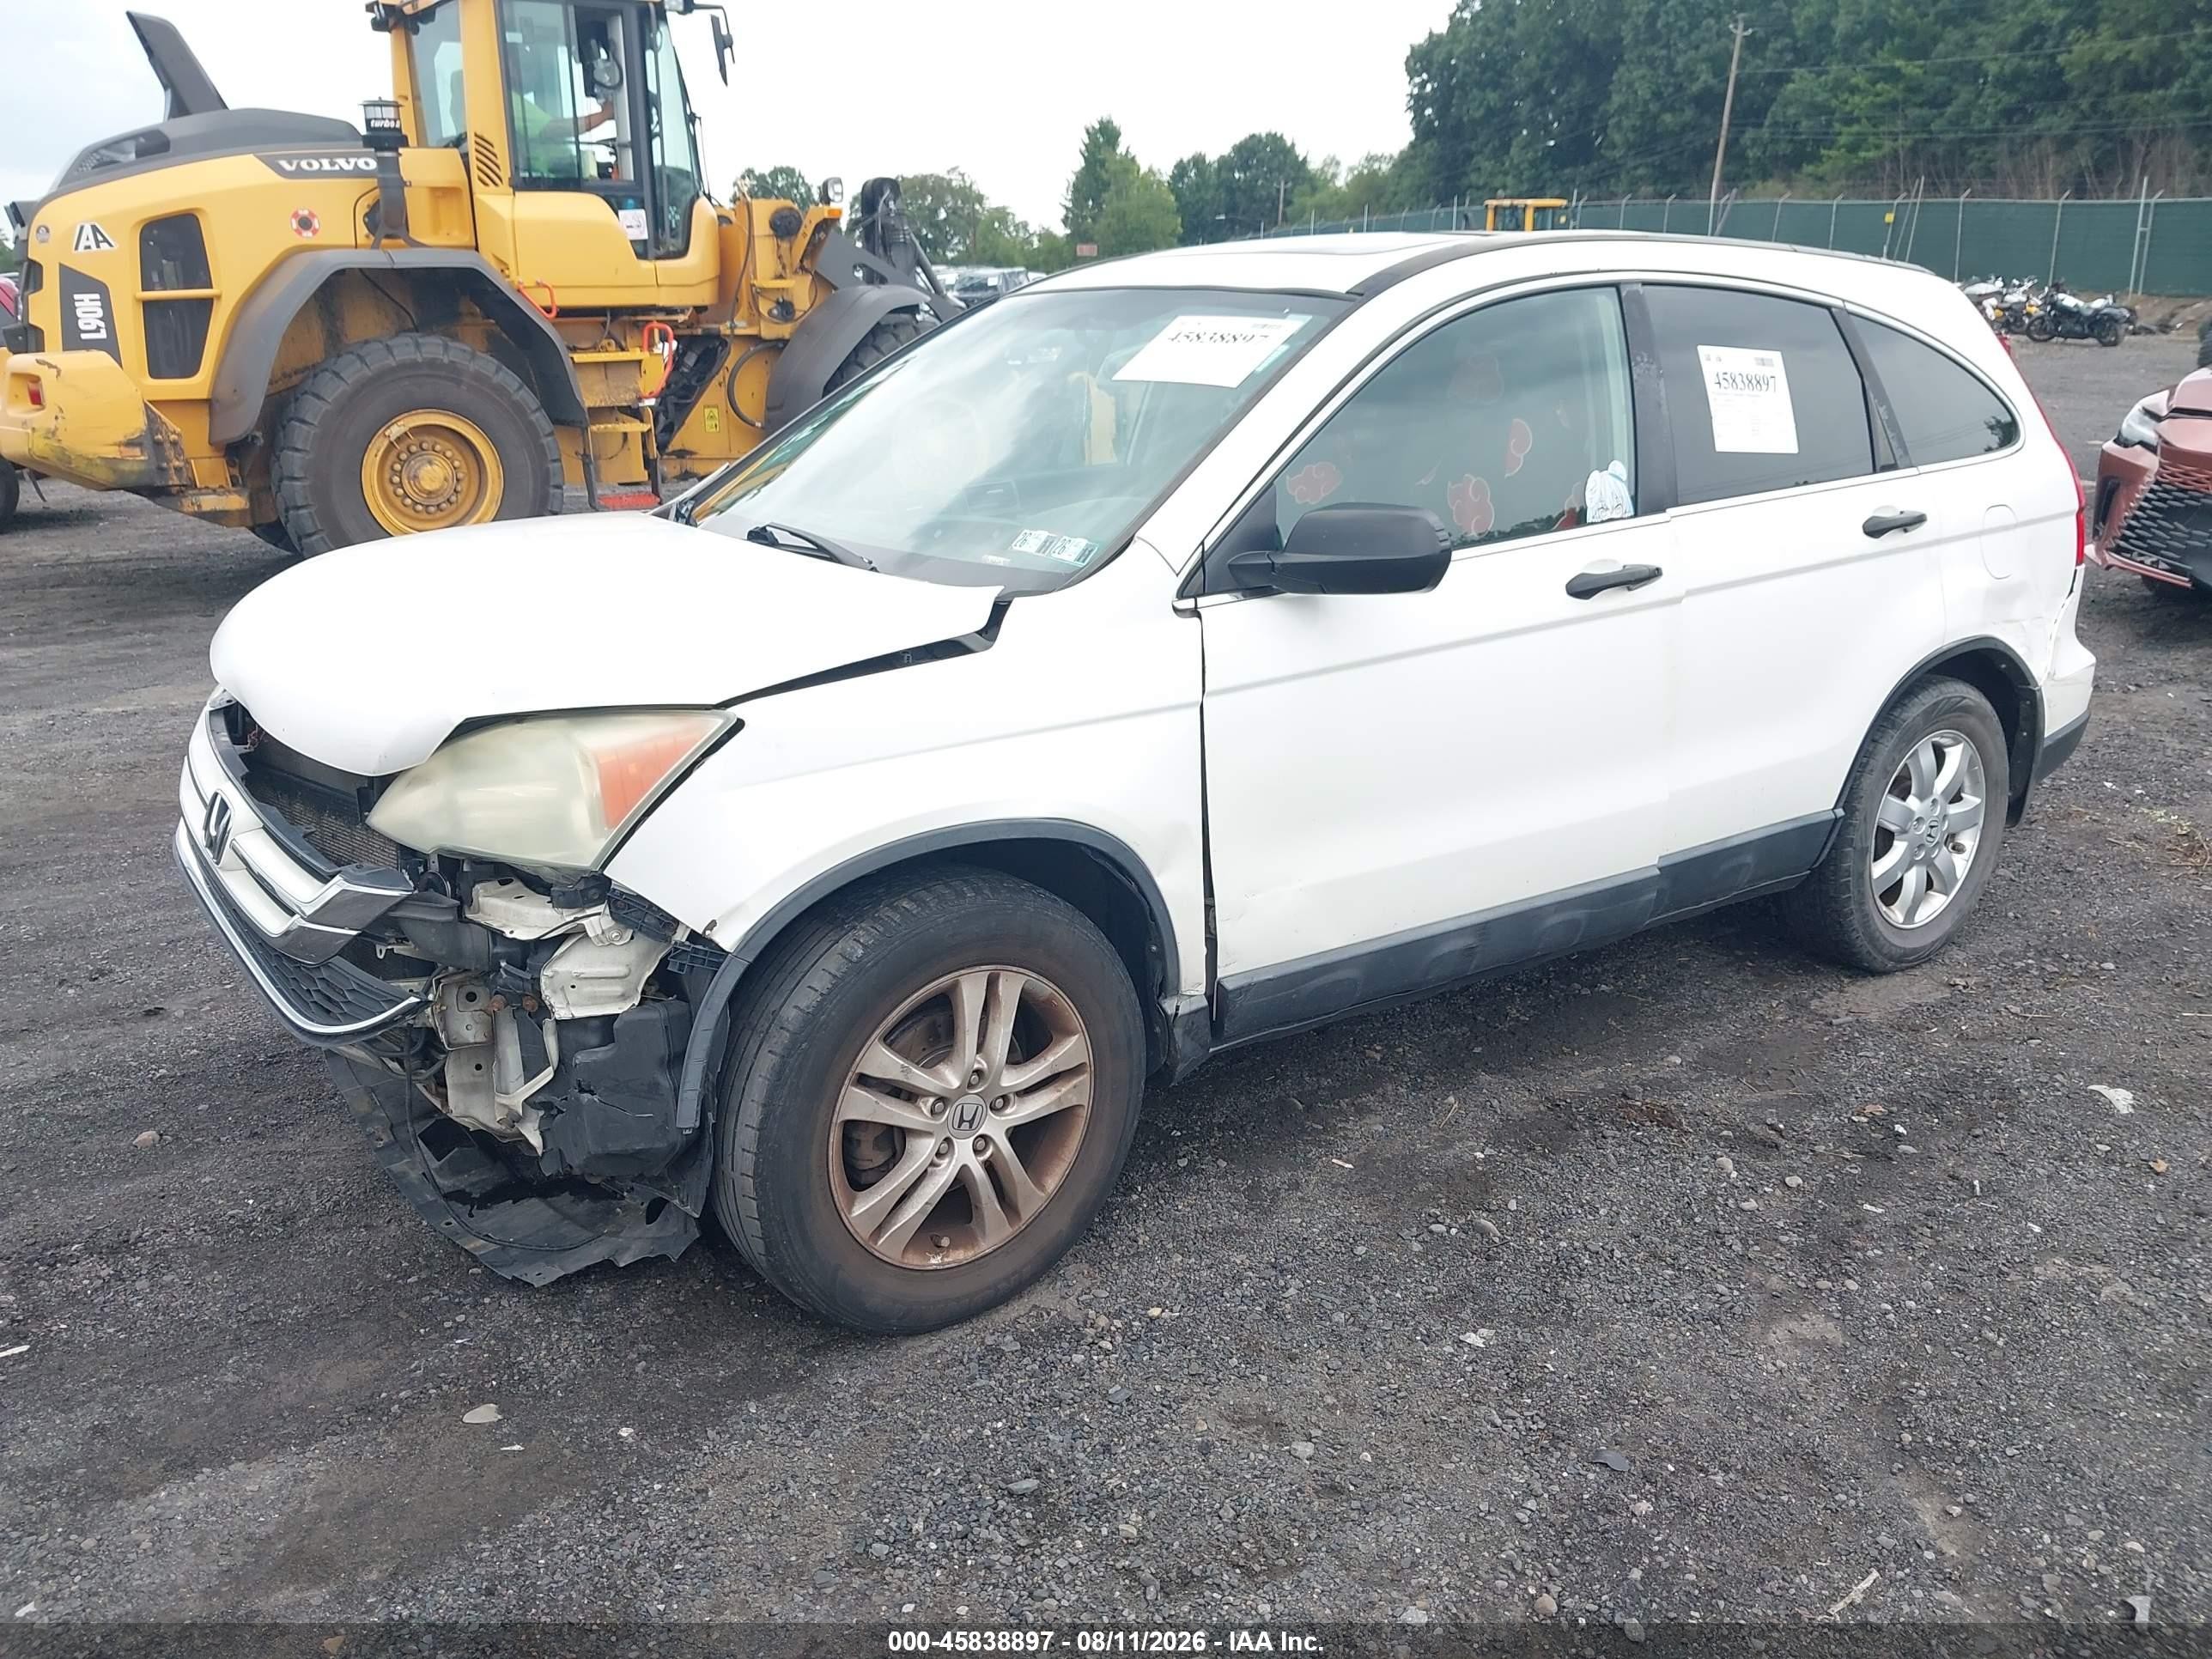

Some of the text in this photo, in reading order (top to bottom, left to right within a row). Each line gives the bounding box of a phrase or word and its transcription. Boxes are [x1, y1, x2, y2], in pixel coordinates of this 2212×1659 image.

[276, 157, 378, 172] VOLVO
[73, 293, 107, 340] L90H
[1714, 371, 1777, 392] 45838897
